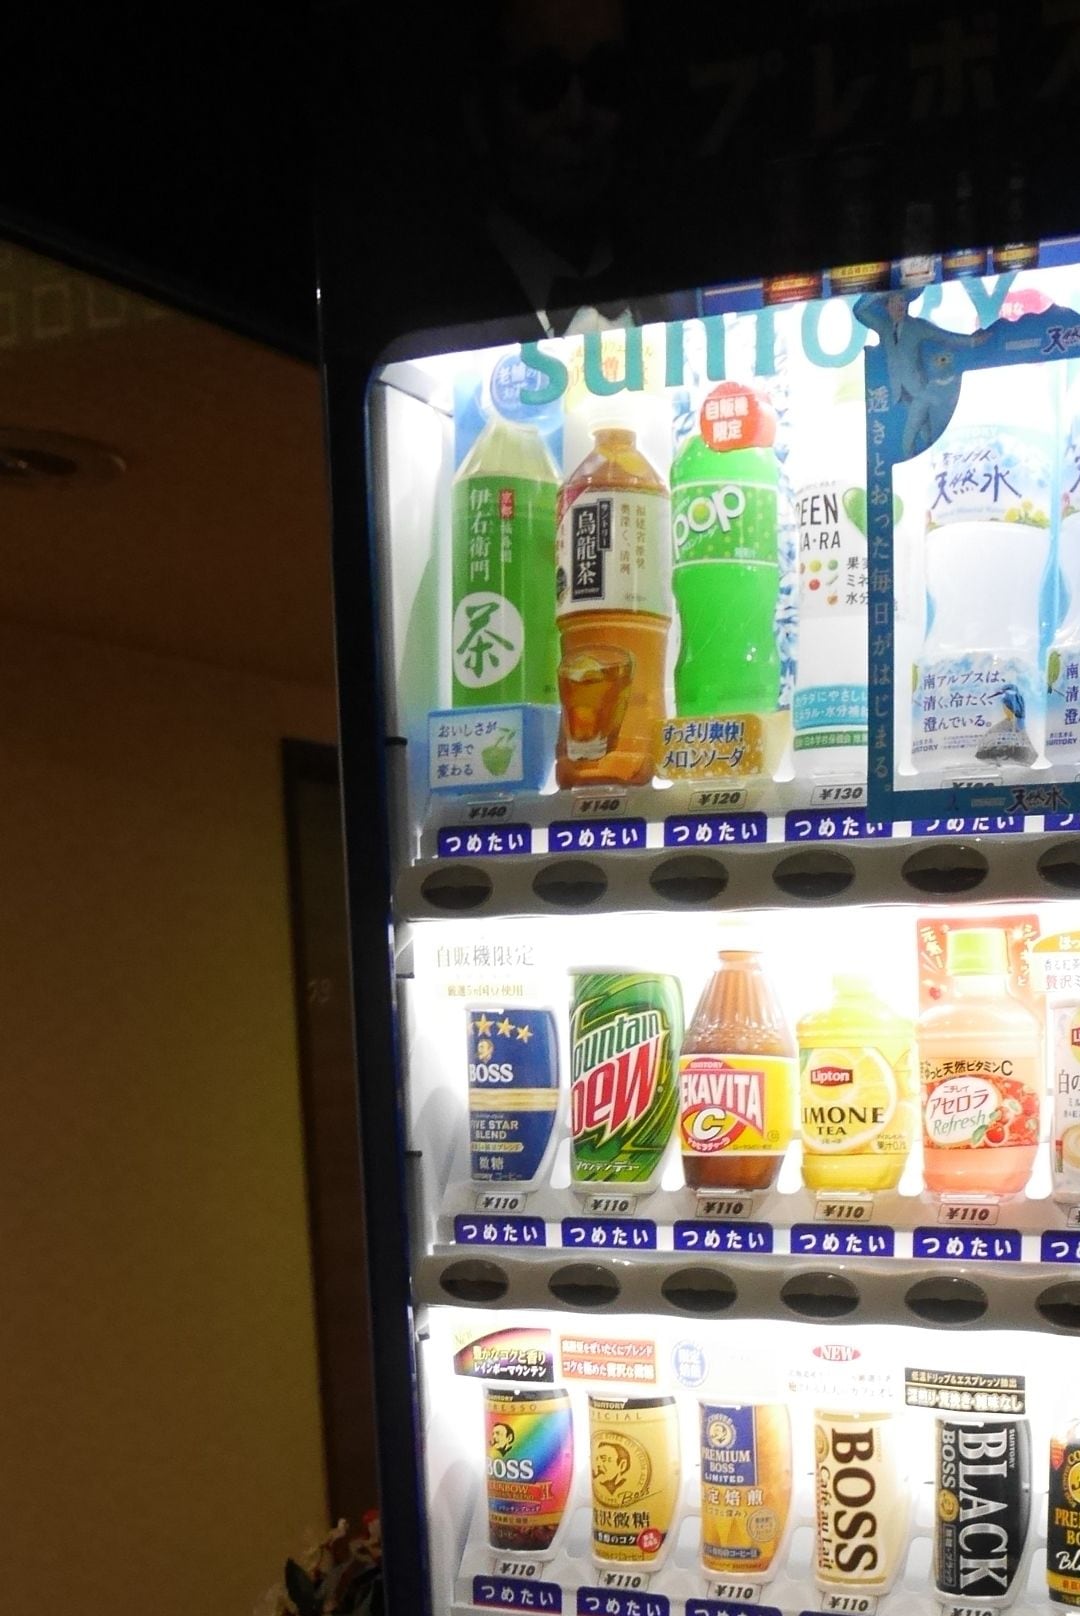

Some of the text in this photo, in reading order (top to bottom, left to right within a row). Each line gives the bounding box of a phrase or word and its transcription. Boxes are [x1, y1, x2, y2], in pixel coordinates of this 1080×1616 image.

[931, 463, 1023, 511] 天然水
[456, 601, 515, 679] 茶
[923, 671, 1006, 690] 南アルプスは、
[437, 720, 498, 739] おいしさが
[923, 716, 992, 733] 澄んでいる。
[663, 744, 747, 769] メロンソーダ
[699, 792, 741, 807] ¥120
[819, 787, 863, 800] ¥130
[580, 799, 620, 813] ¥140
[556, 826, 639, 848] つめたい
[672, 821, 759, 843] つめたい
[794, 817, 884, 838] つめたい
[445, 832, 524, 853] つめたい
[437, 944, 537, 968] 自販機限定
[574, 1012, 661, 1080] ountain
[811, 1069, 850, 1083] Lipton
[681, 1073, 764, 1132] EKAVITA
[930, 1090, 990, 1117] アセロラ
[488, 1119, 519, 1130] STAR
[692, 1107, 727, 1140] C
[802, 1106, 885, 1124] IMONE
[932, 1110, 987, 1136] Refresh
[475, 1130, 507, 1139] BLEND
[816, 1126, 847, 1136] TEA
[482, 1196, 519, 1210] ¥110
[590, 1199, 629, 1213] ¥110
[703, 1201, 743, 1215] ¥110
[823, 1206, 865, 1219] ¥110
[946, 1207, 990, 1221] ¥110
[462, 1223, 538, 1242] つめたい
[569, 1225, 649, 1246] つめたい
[682, 1228, 765, 1248] つめたい
[799, 1233, 886, 1253] つめたい
[922, 1236, 1012, 1257] つめたい
[709, 1462, 735, 1474] BOSS
[942, 1429, 956, 1489] BOSS
[704, 1472, 745, 1483] LIMITED
[831, 1427, 878, 1573] BOSS
[958, 1428, 1009, 1590] BLACK
[500, 1562, 536, 1577] ¥110
[604, 1572, 641, 1588] ¥110
[481, 1584, 554, 1606] つめたい
[715, 1584, 754, 1599] ¥110
[828, 1597, 869, 1612] ¥110
